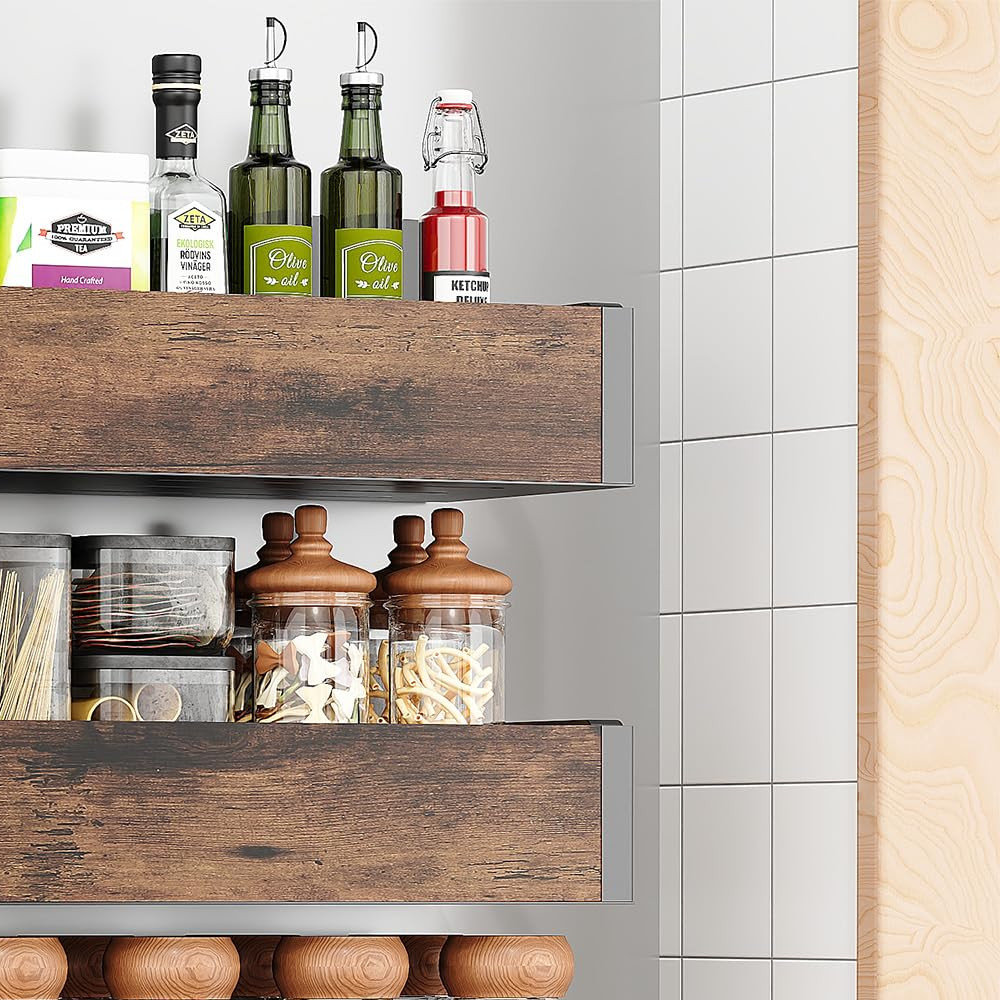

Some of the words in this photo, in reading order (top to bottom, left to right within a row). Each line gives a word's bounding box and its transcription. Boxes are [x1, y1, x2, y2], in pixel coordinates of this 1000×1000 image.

[184, 214, 206, 224] ZETA
[57, 224, 108, 235] PREMIUM
[74, 244, 88, 253] TEA
[176, 239, 214, 248] EKOLOGISK
[180, 248, 212, 260] RÖDVINS
[268, 248, 308, 270] Olive
[360, 252, 398, 274] Olive
[61, 276, 78, 284] Hand
[80, 276, 104, 285] Crafted
[280, 276, 298, 287] oil
[372, 278, 390, 290] oil
